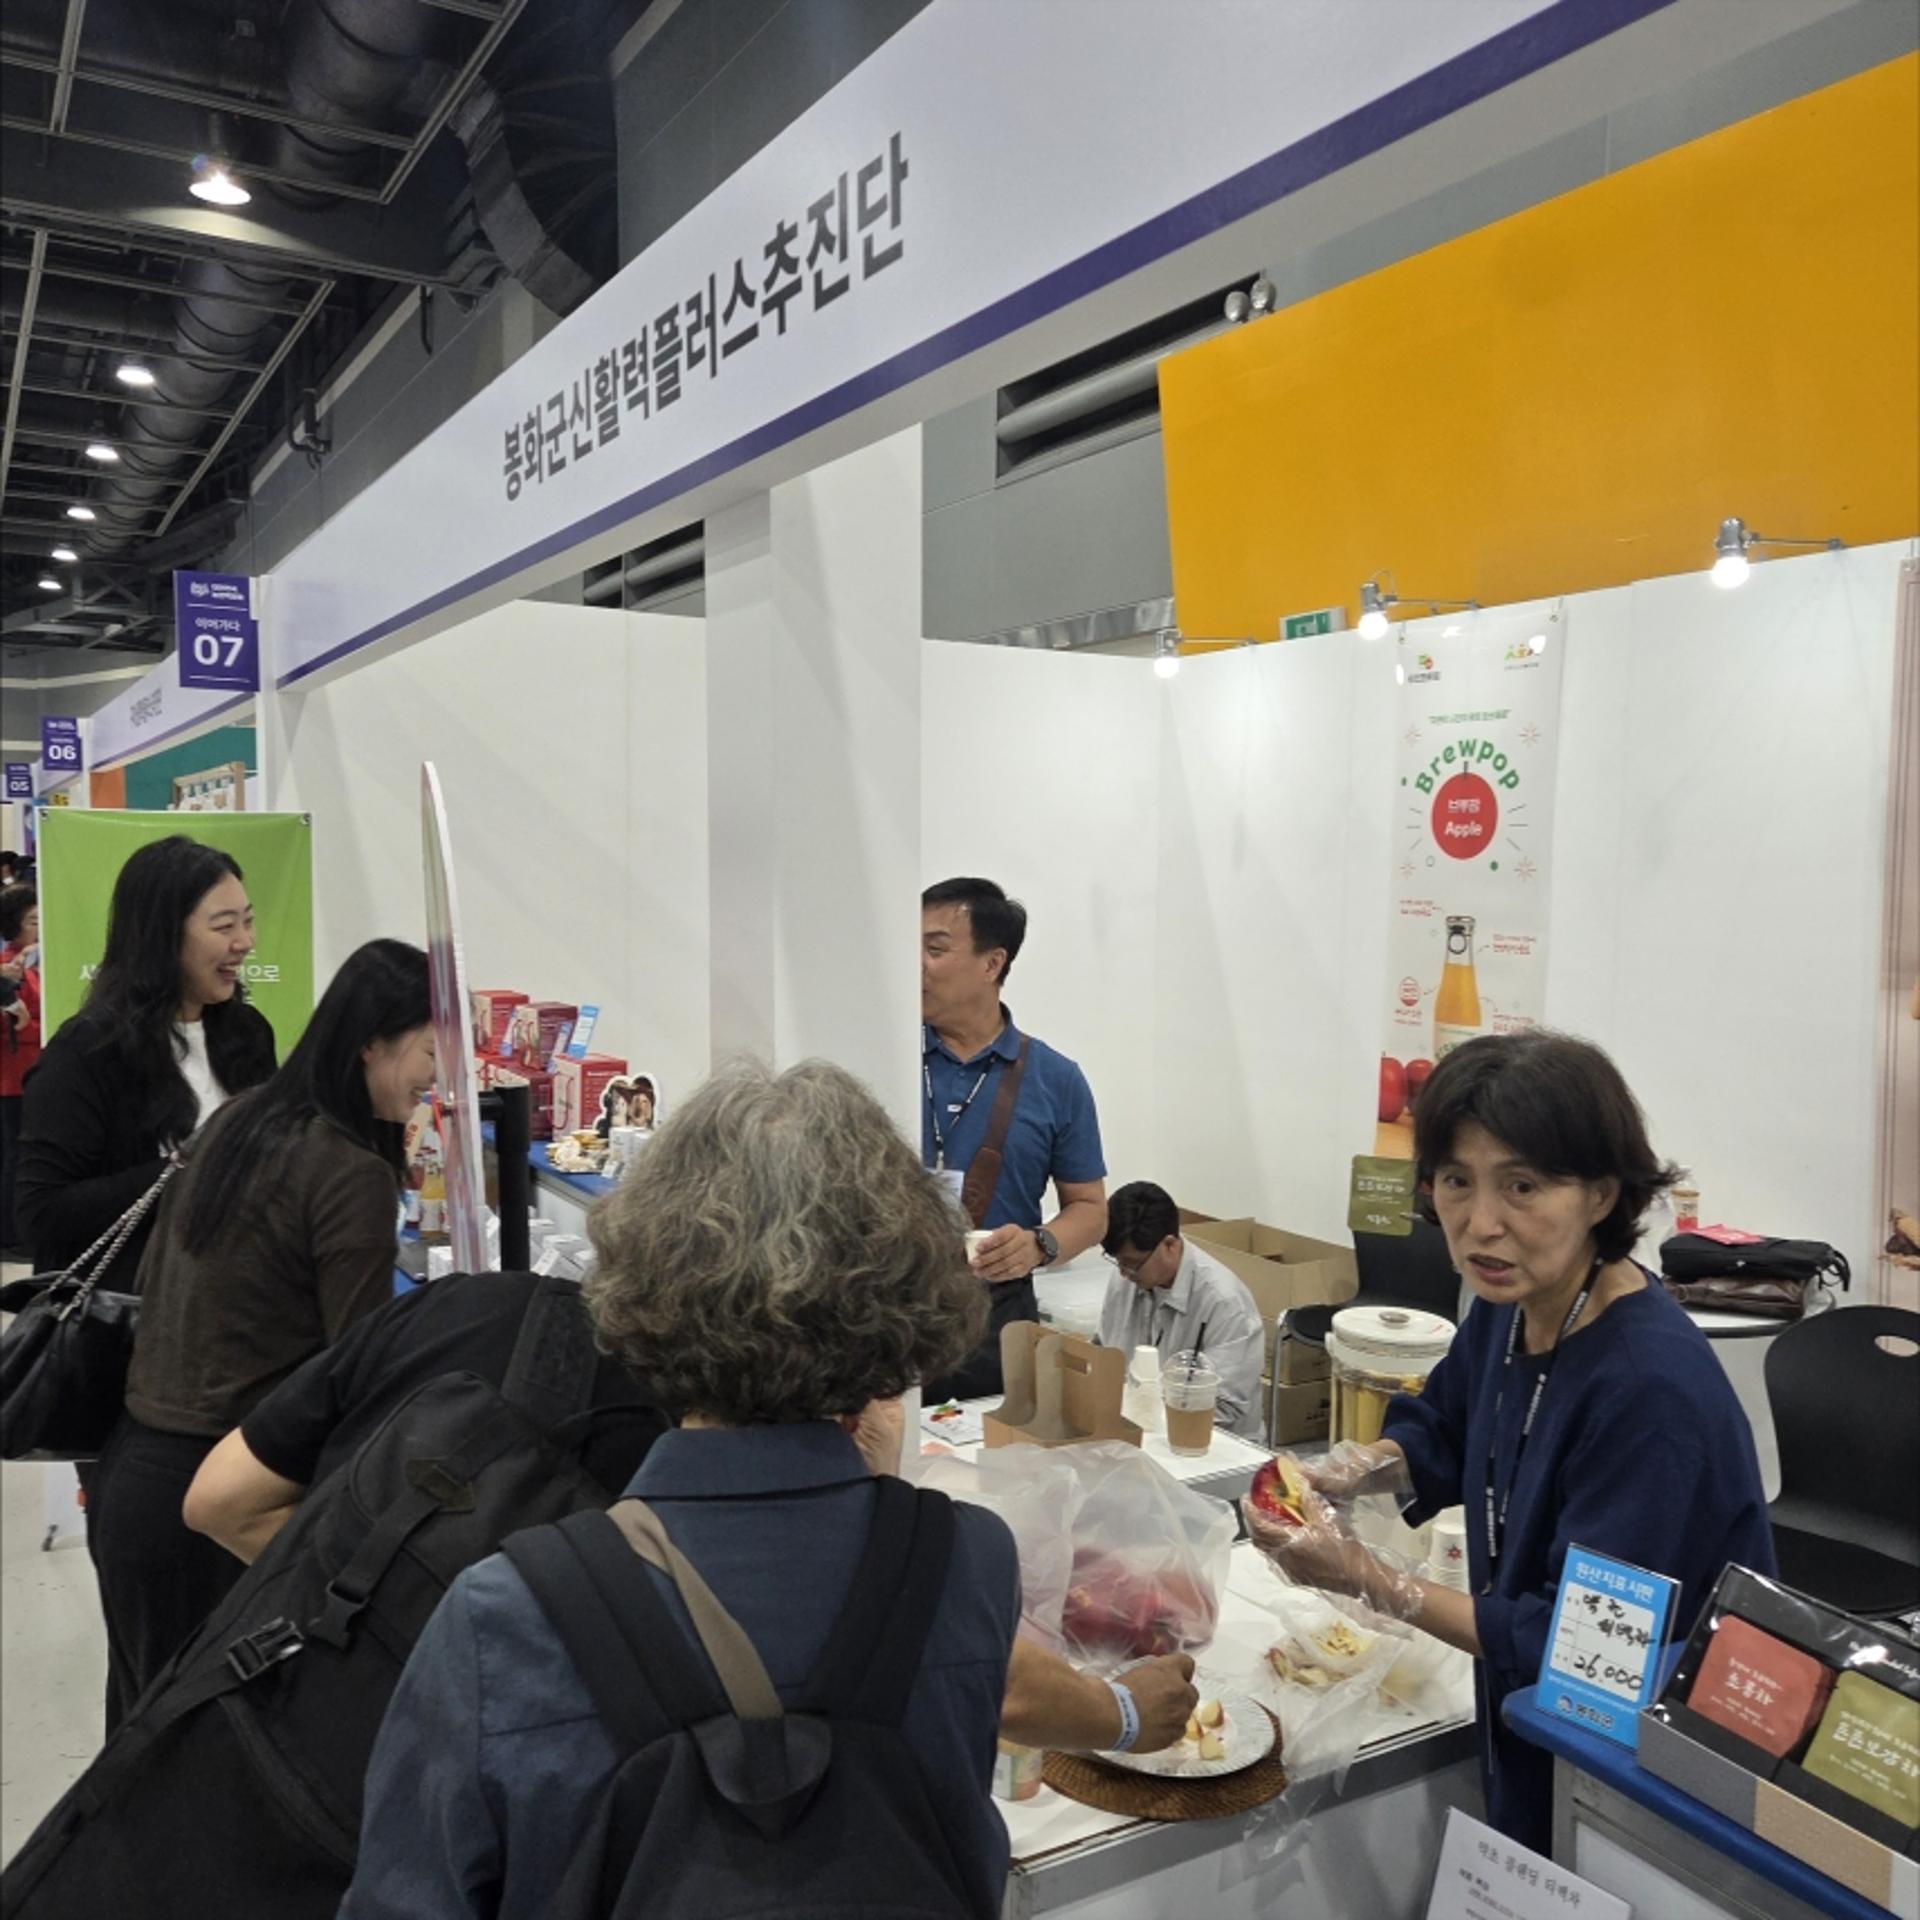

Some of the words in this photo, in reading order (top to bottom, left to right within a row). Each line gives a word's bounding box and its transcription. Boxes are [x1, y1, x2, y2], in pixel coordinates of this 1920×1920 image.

[503, 130, 909, 502] 봉화군신활력플러스추진단
[193, 634, 244, 667] 07
[48, 745, 77, 760] 06
[1414, 738, 1520, 795] Brewpop
[1444, 820, 1483, 839] Apple
